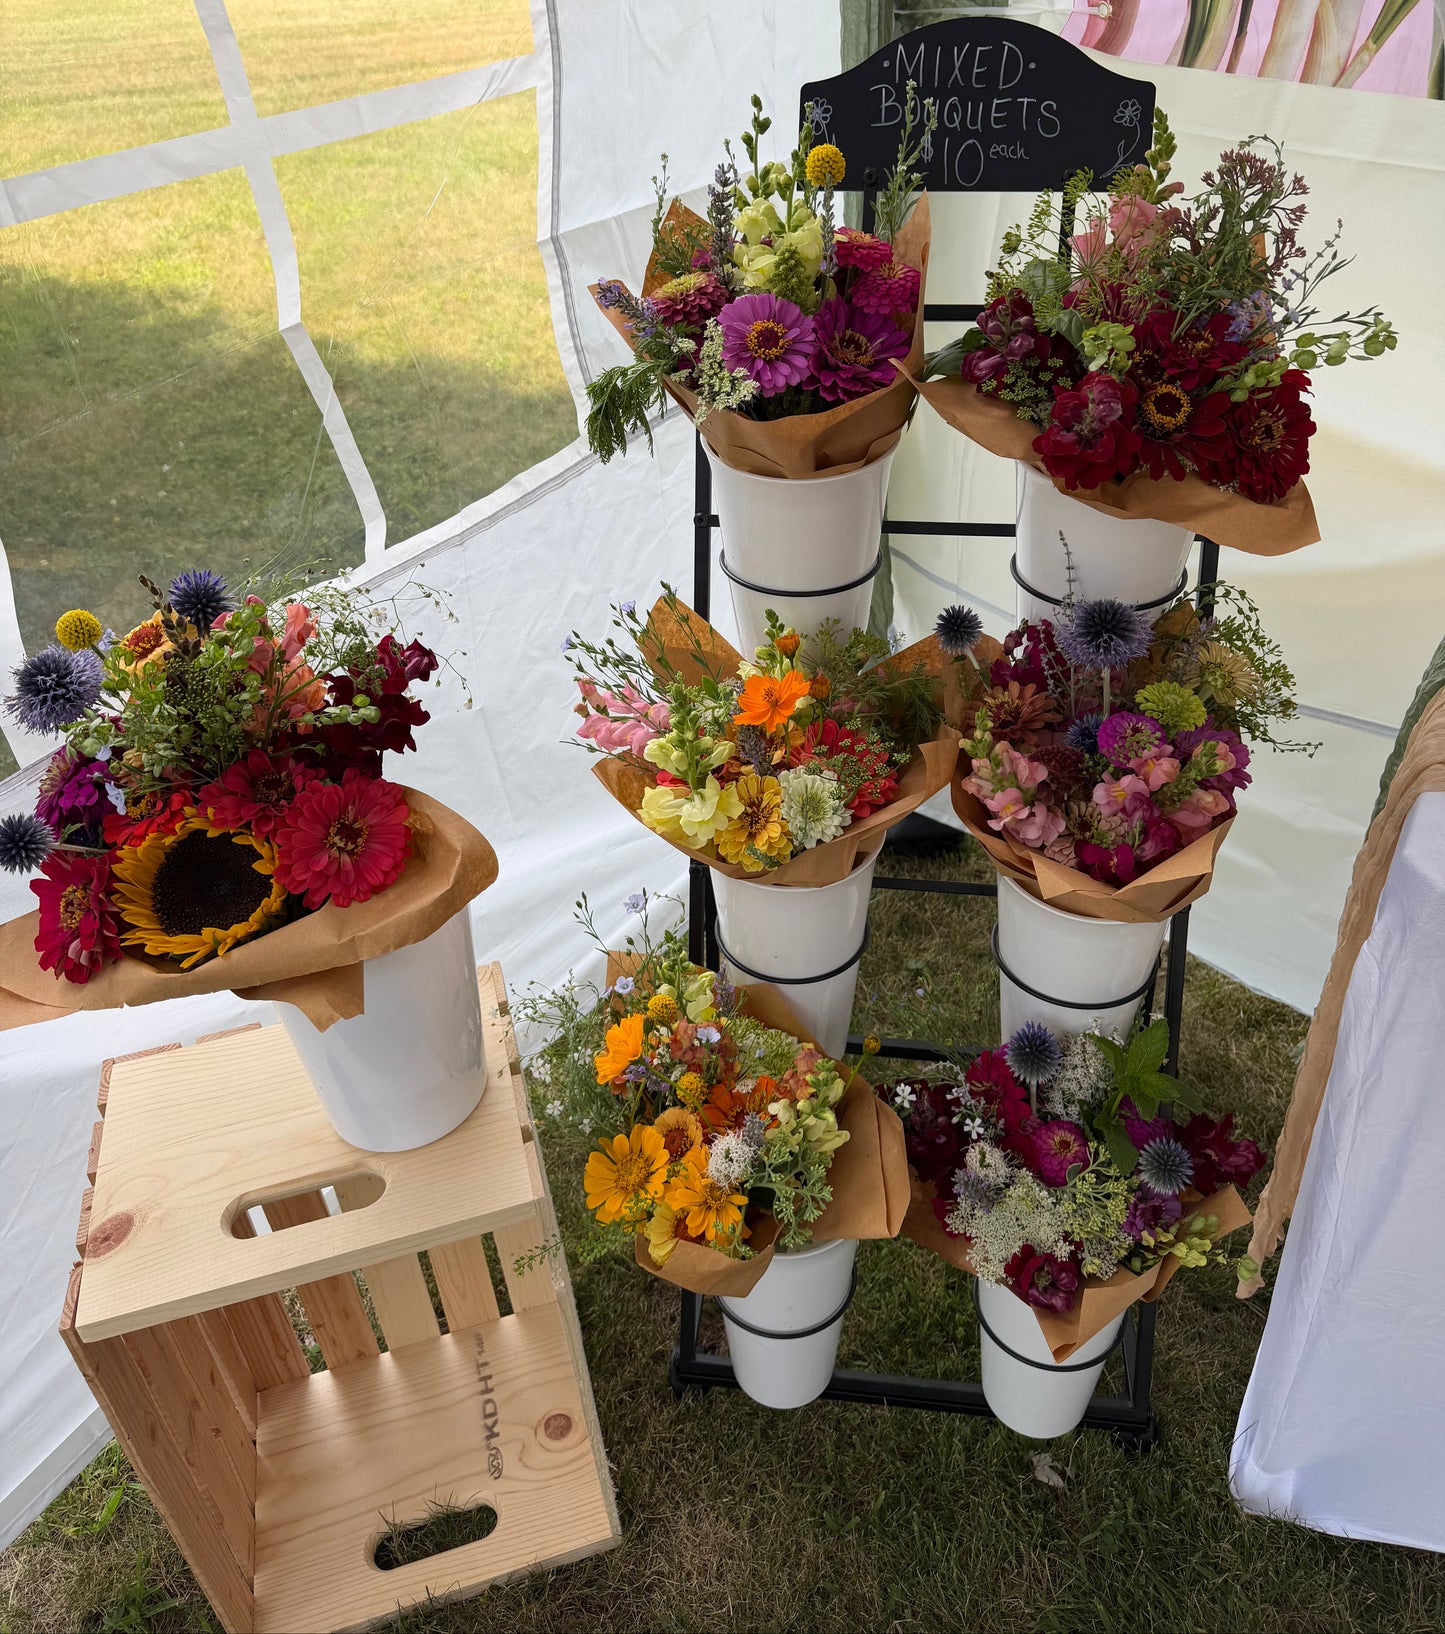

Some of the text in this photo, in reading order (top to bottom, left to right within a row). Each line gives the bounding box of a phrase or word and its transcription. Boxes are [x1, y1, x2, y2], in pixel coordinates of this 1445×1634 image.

[895, 40, 1024, 90] MIXED
[869, 84, 1061, 138] BOUQUETS
[989, 140, 1029, 160] each
